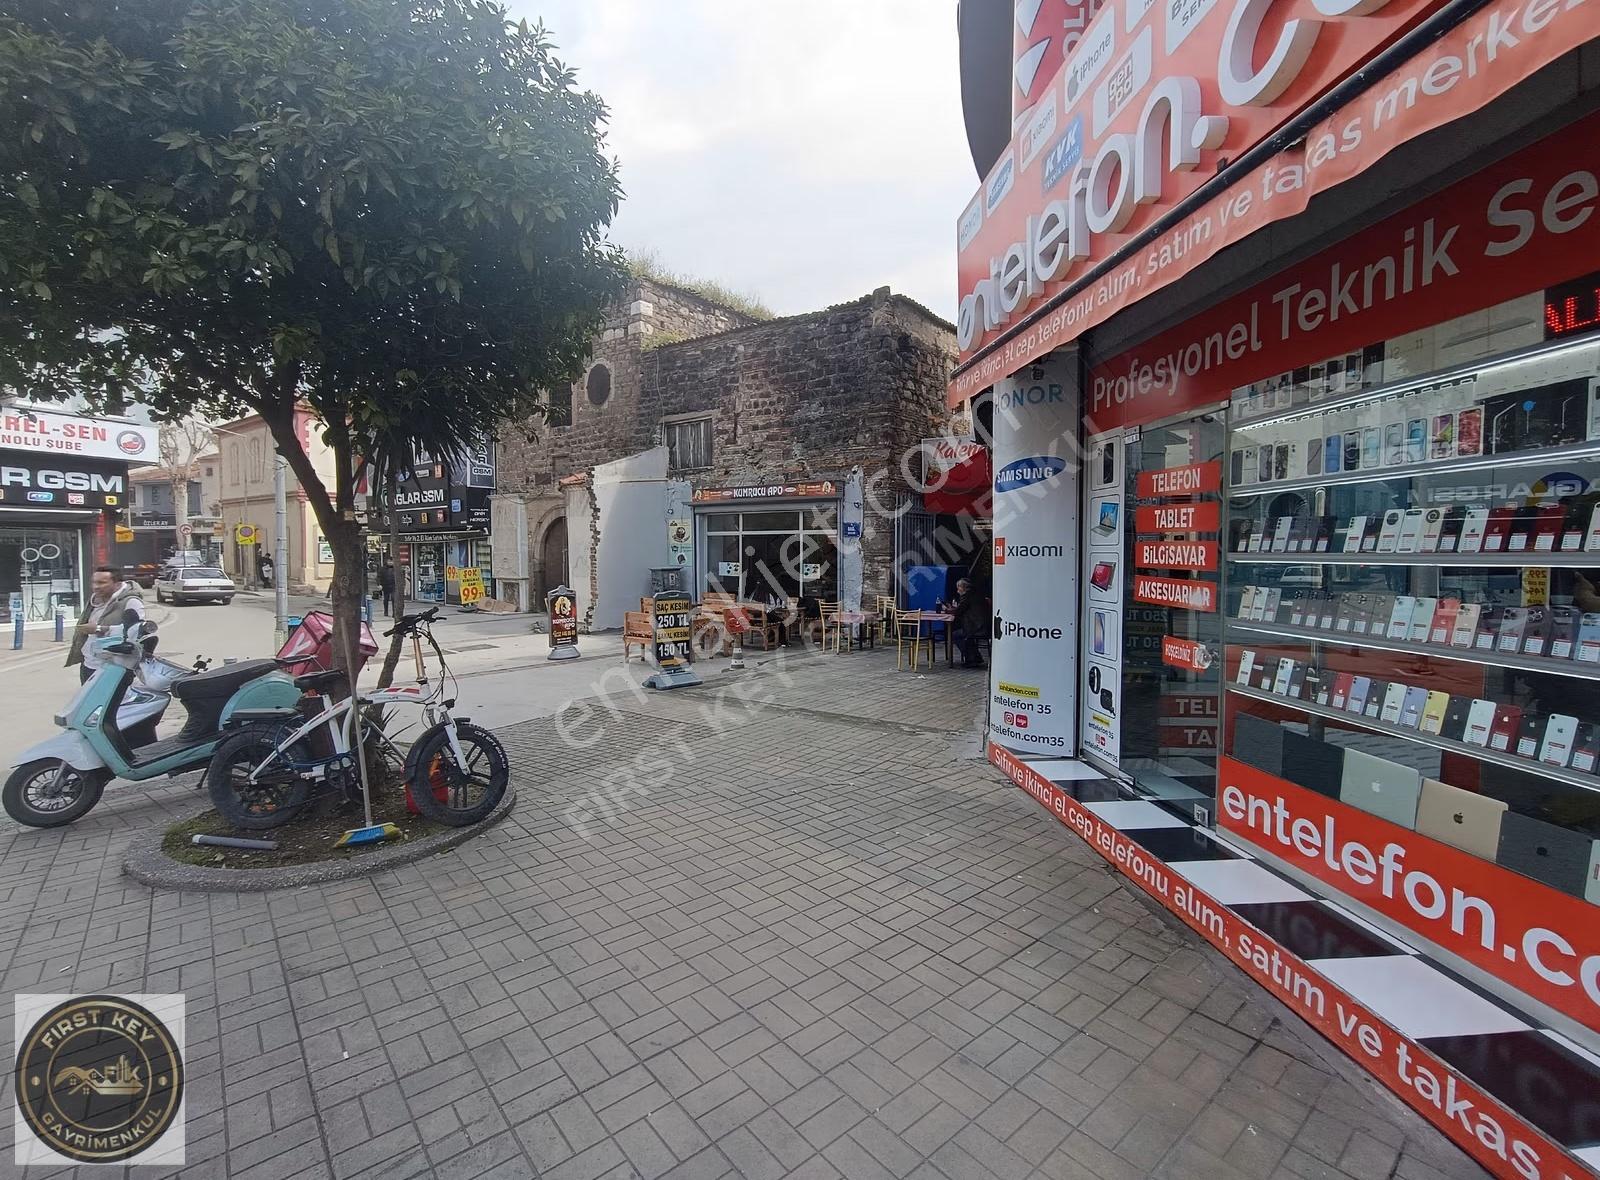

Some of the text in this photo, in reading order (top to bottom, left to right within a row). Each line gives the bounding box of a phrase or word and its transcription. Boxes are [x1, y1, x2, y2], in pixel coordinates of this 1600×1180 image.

[1045, 121, 1080, 178] KVK
[957, 0, 1390, 350] entelefon.c
[1016, 334, 1036, 357] cep
[1038, 293, 1095, 344] telefonu
[1147, 214, 1213, 276] satım
[1219, 189, 1253, 229] ve
[1373, 0, 1586, 132] merke
[1092, 300, 1263, 413] Profesyonel
[1271, 217, 1461, 341] Teknik
[0, 414, 107, 442] REL-SEN
[2, 433, 41, 447] NOLU
[37, 469, 123, 493] GSM
[997, 466, 1053, 484] SAMSUNG
[1151, 468, 1201, 494] TELEFON
[733, 486, 766, 498] KUMRUCU
[767, 486, 783, 497] APO
[1154, 507, 1195, 529] TABLET
[1142, 544, 1206, 567] BİLGİSAYAR
[656, 601, 689, 613] SAÇ KESİM
[658, 613, 690, 628] 250 TL
[1004, 620, 1063, 640] iPhone
[658, 642, 690, 657] 150 TL
[1036, 703, 1052, 715] 35
[1183, 729, 1218, 745] TA
[994, 748, 1541, 1180] Sıfır ve ikinci el cep telefonu alım, satım ve takas
